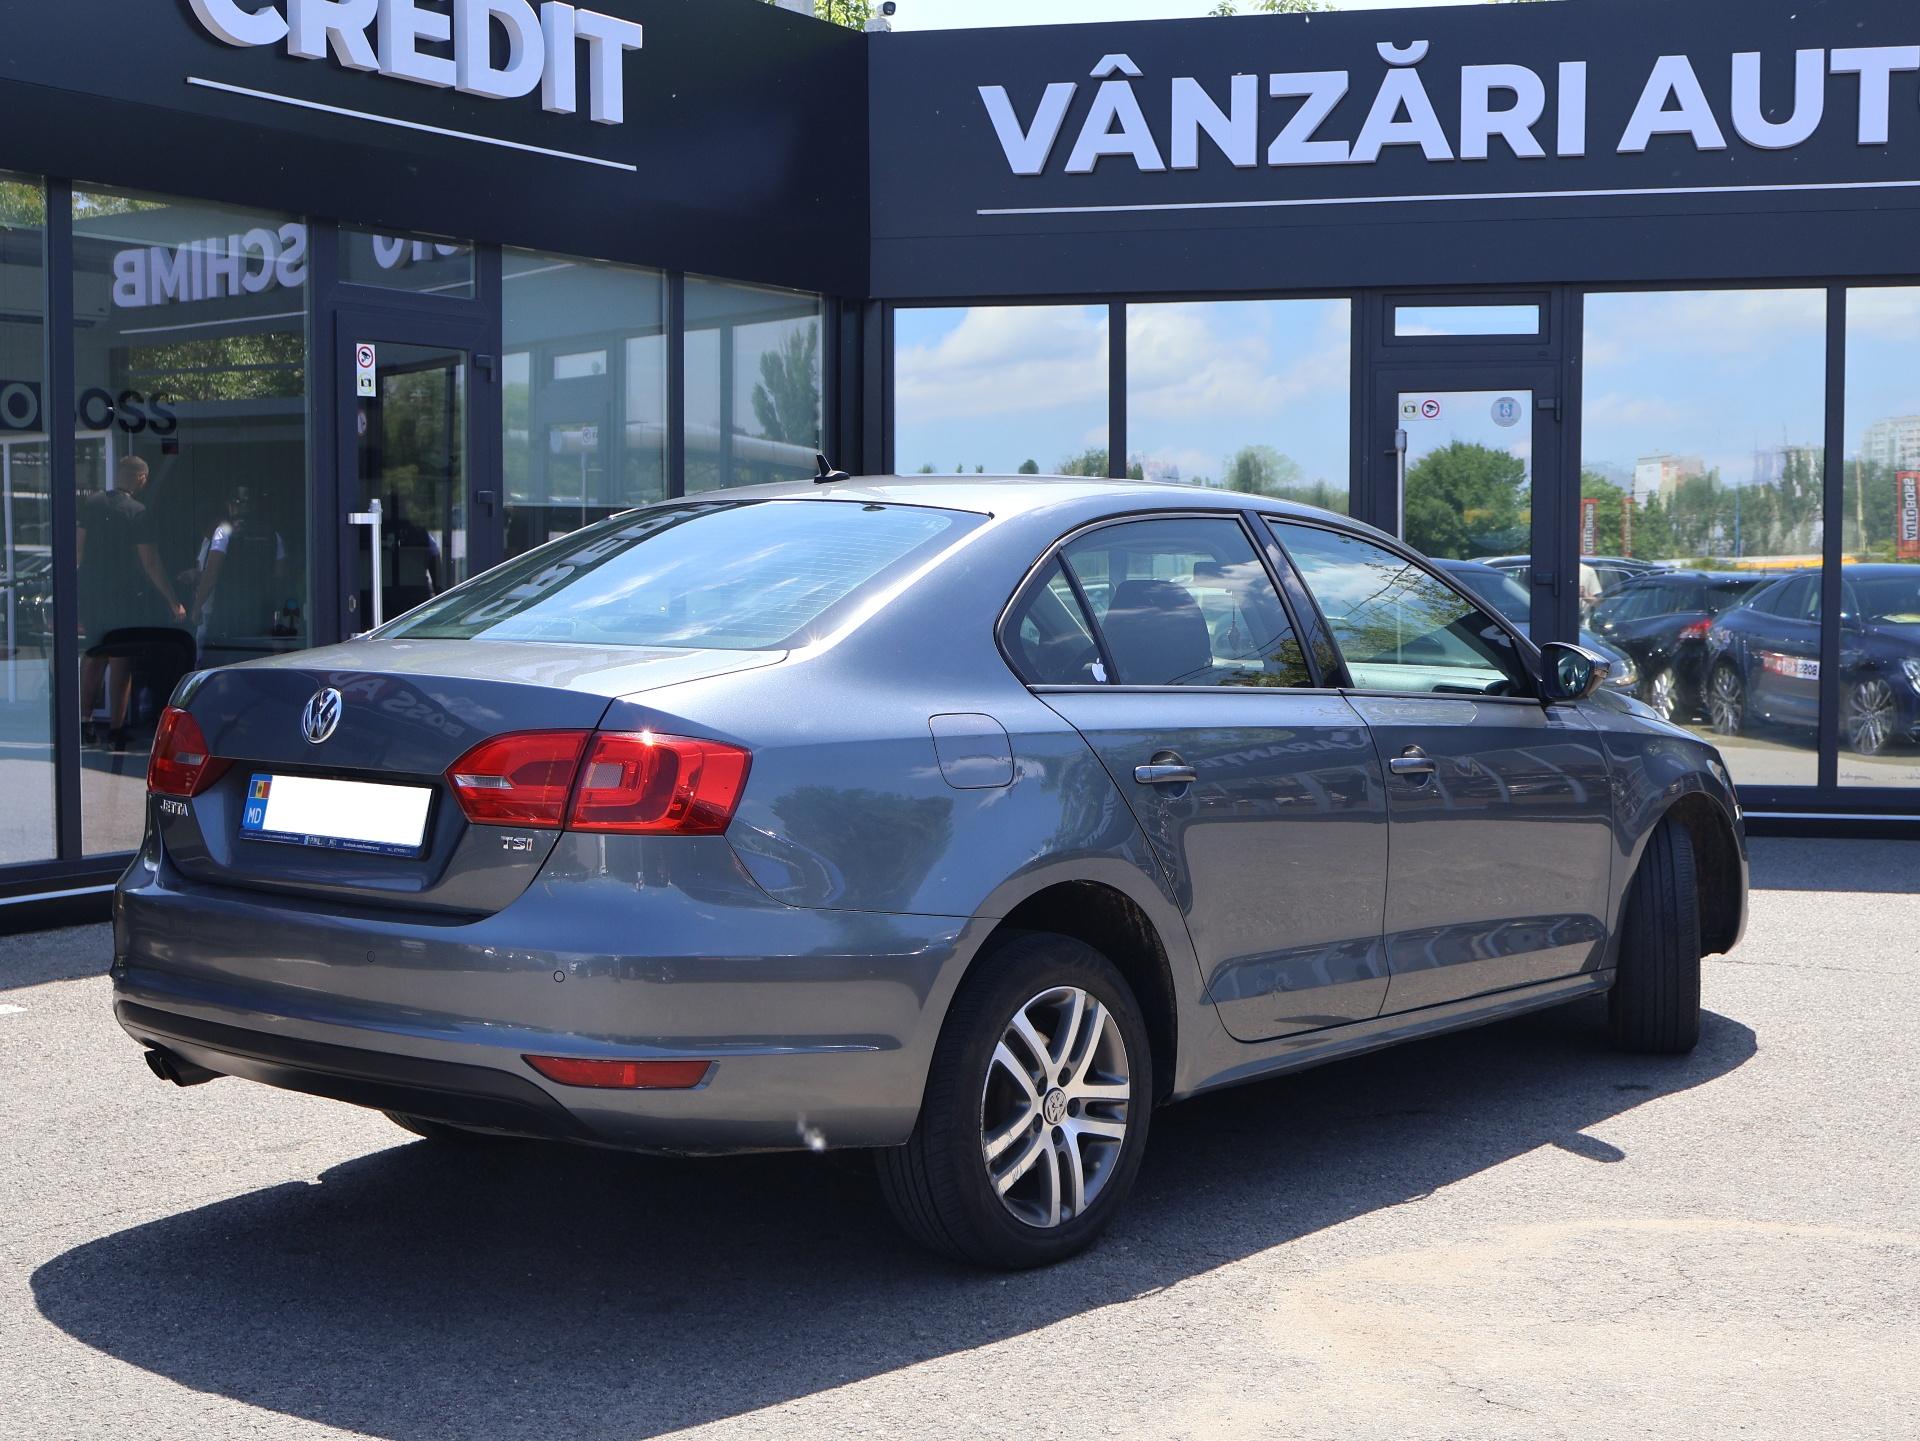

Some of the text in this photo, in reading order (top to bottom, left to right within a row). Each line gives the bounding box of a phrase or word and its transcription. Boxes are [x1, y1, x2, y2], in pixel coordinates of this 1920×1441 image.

[977, 39, 1920, 176] VÂNZĂRI AUT
[74, 387, 177, 435] OSS
[160, 799, 189, 817] JETTA
[247, 807, 262, 824] MD
[500, 835, 533, 852] TSI
